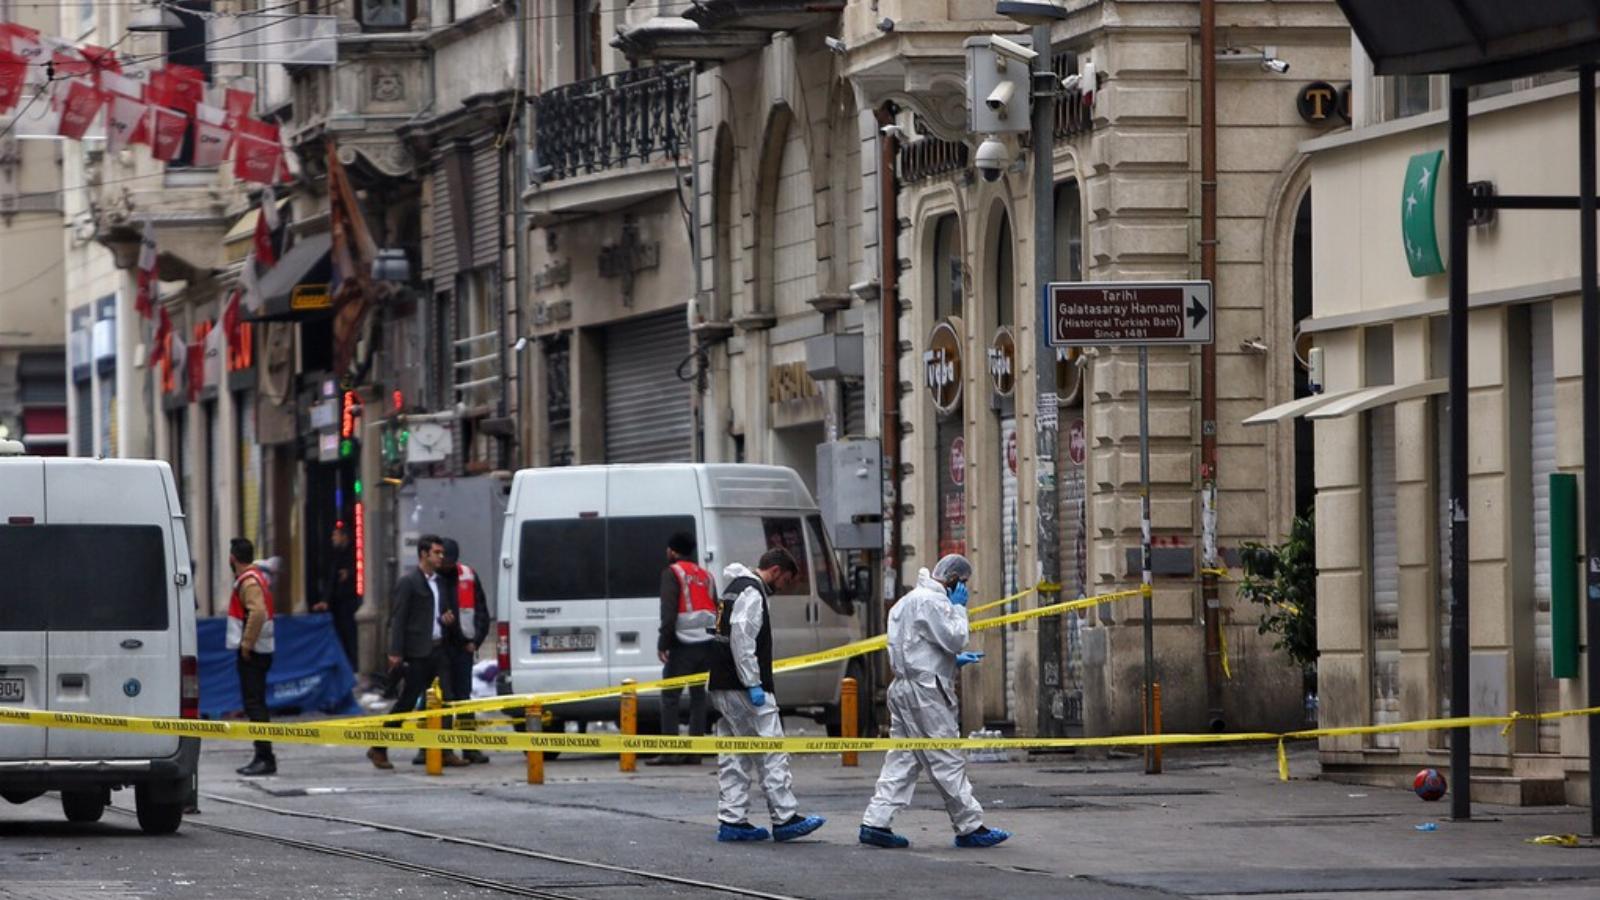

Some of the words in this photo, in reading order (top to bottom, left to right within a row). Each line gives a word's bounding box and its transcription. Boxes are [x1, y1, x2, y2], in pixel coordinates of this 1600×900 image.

[1102, 289, 1138, 301] Tarihi
[1059, 303, 1128, 317] Galatasaray
[1113, 317, 1150, 328] Turkish
[1094, 329, 1121, 338] Since
